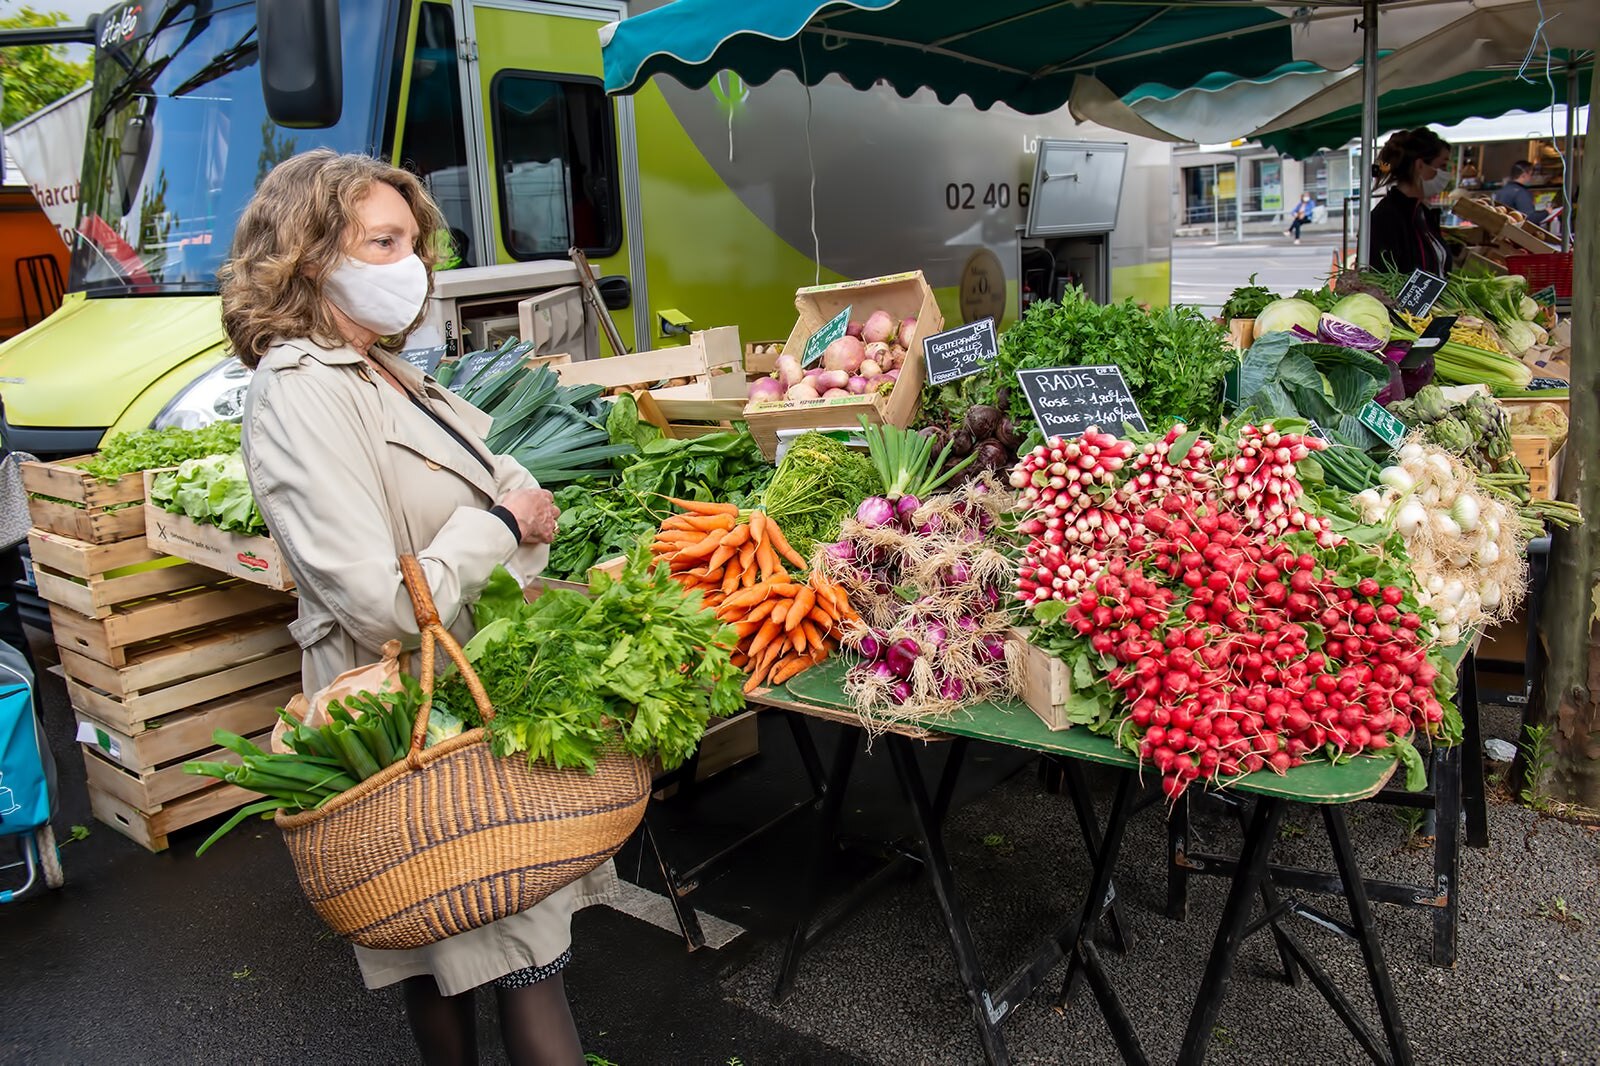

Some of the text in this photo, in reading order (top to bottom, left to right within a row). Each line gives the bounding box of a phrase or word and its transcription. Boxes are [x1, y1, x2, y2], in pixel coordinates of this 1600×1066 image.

[945, 182, 976, 210] 02
[983, 182, 1010, 208] 40
[1042, 412, 1081, 426] ROUGE
